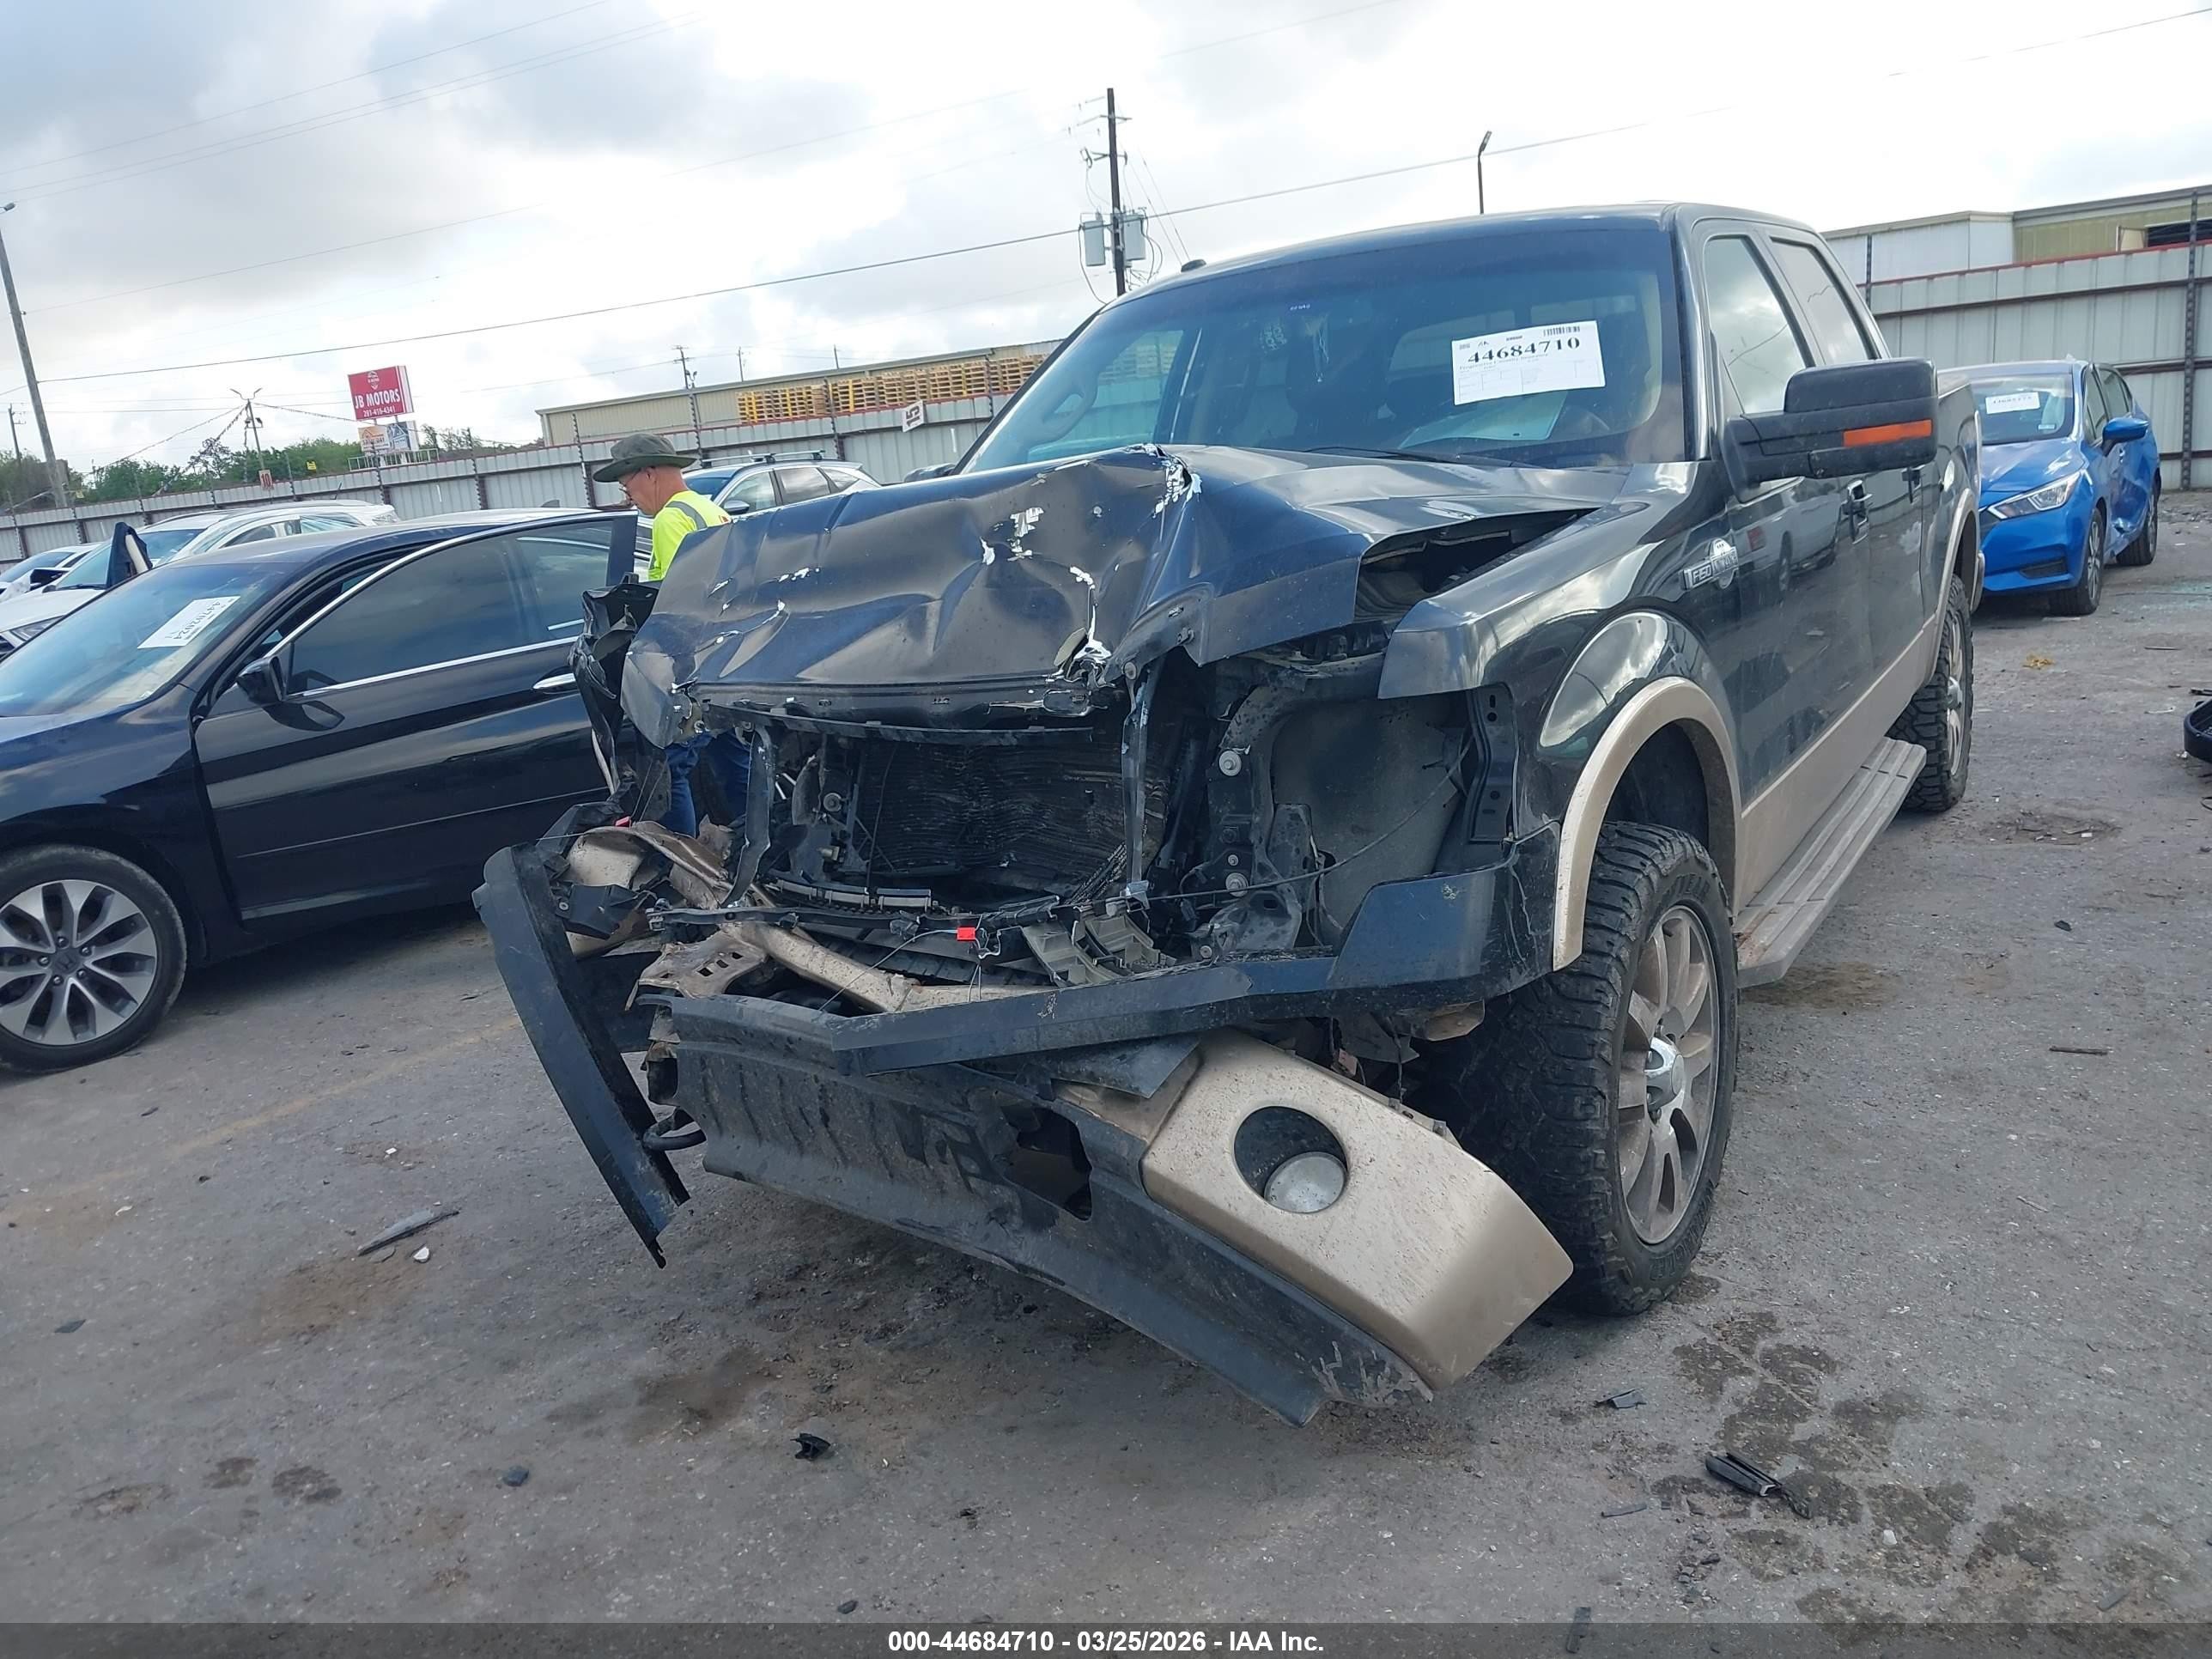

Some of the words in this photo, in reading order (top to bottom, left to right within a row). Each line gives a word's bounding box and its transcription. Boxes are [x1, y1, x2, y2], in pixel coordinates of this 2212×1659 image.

[1468, 337, 1580, 362] 44684710
[355, 395, 365, 409] JB
[366, 388, 401, 407] MOTORS
[906, 405, 921, 428] 15
[261, 473, 271, 488] 10
